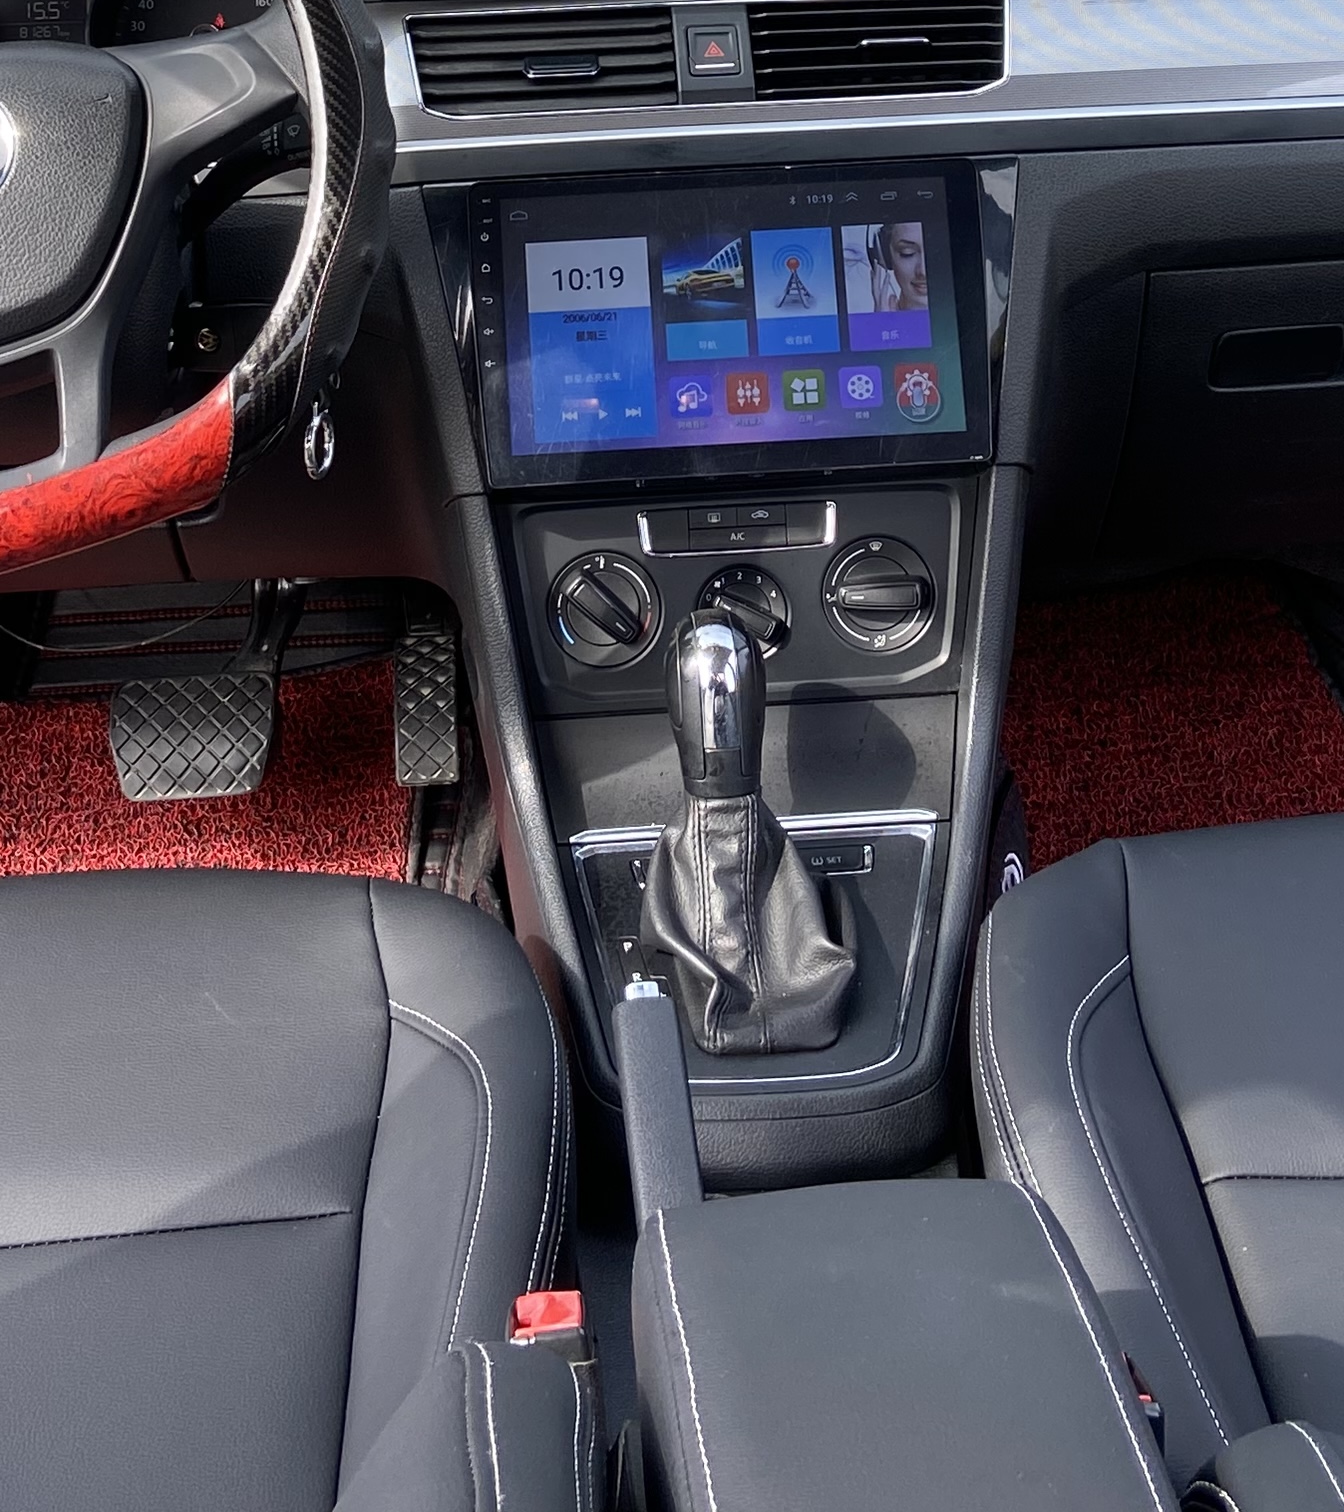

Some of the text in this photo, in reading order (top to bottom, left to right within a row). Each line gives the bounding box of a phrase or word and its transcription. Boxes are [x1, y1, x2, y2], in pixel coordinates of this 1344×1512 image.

[138, 0, 155, 10] 40
[130, 20, 146, 32] 30
[806, 193, 834, 204] 10:19
[552, 265, 624, 291] 10:19
[730, 532, 745, 540] A/C
[737, 572, 742, 580] 2
[756, 576, 761, 584] 3
[826, 855, 842, 864] SET
